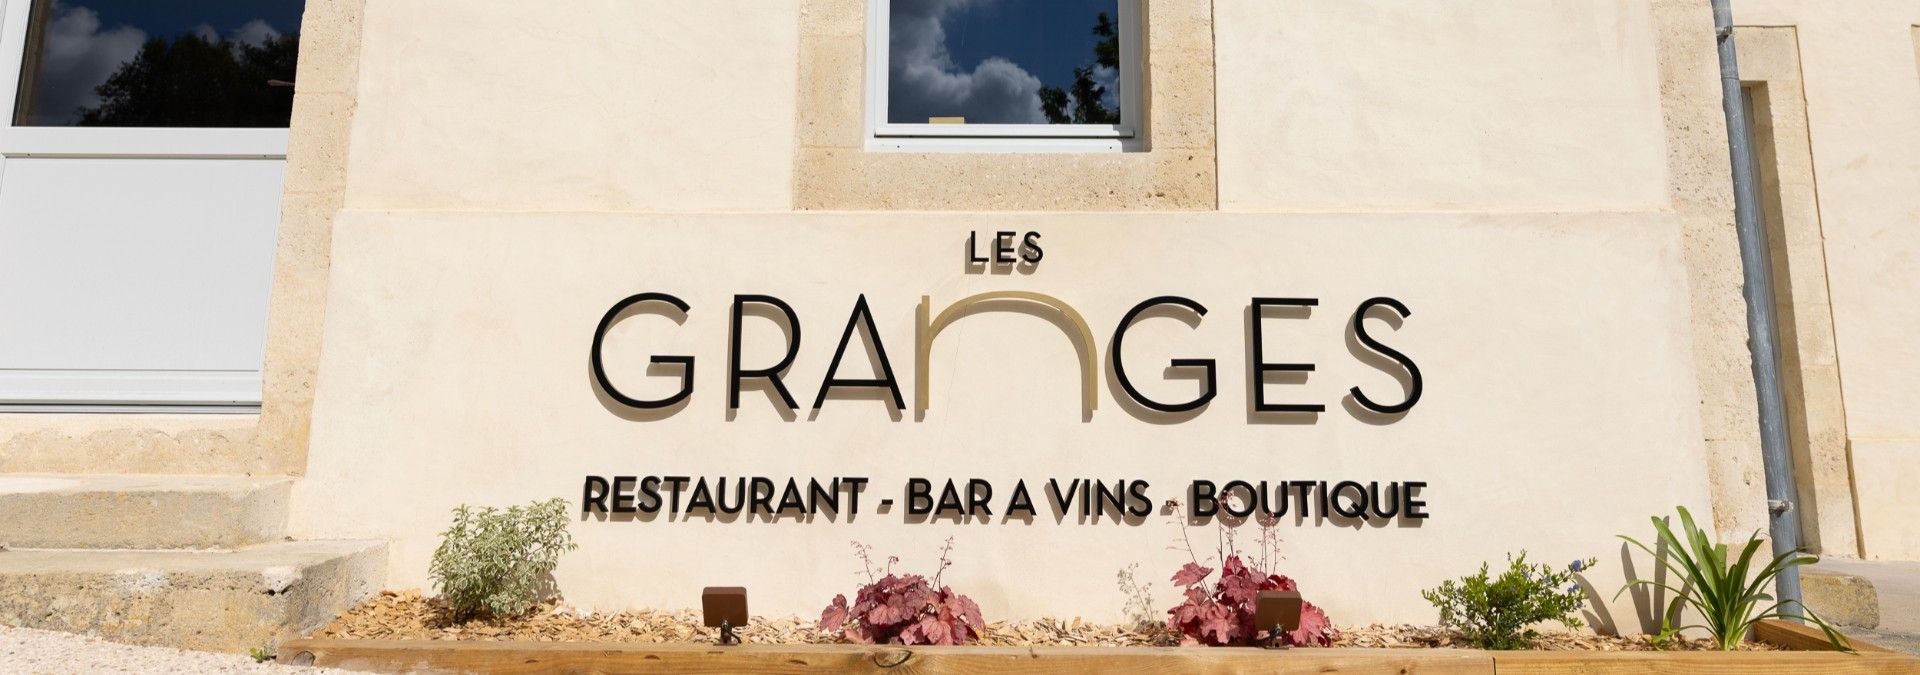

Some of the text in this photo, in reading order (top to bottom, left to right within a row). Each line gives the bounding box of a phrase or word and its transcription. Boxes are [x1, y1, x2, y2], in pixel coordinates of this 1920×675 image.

[970, 230, 1044, 264] LES
[583, 475, 869, 515] RESTAURANT
[908, 478, 993, 516] BAR
[1005, 478, 1037, 516] A
[1049, 478, 1153, 518] VINS
[1192, 480, 1429, 521] BOUTIQUE
